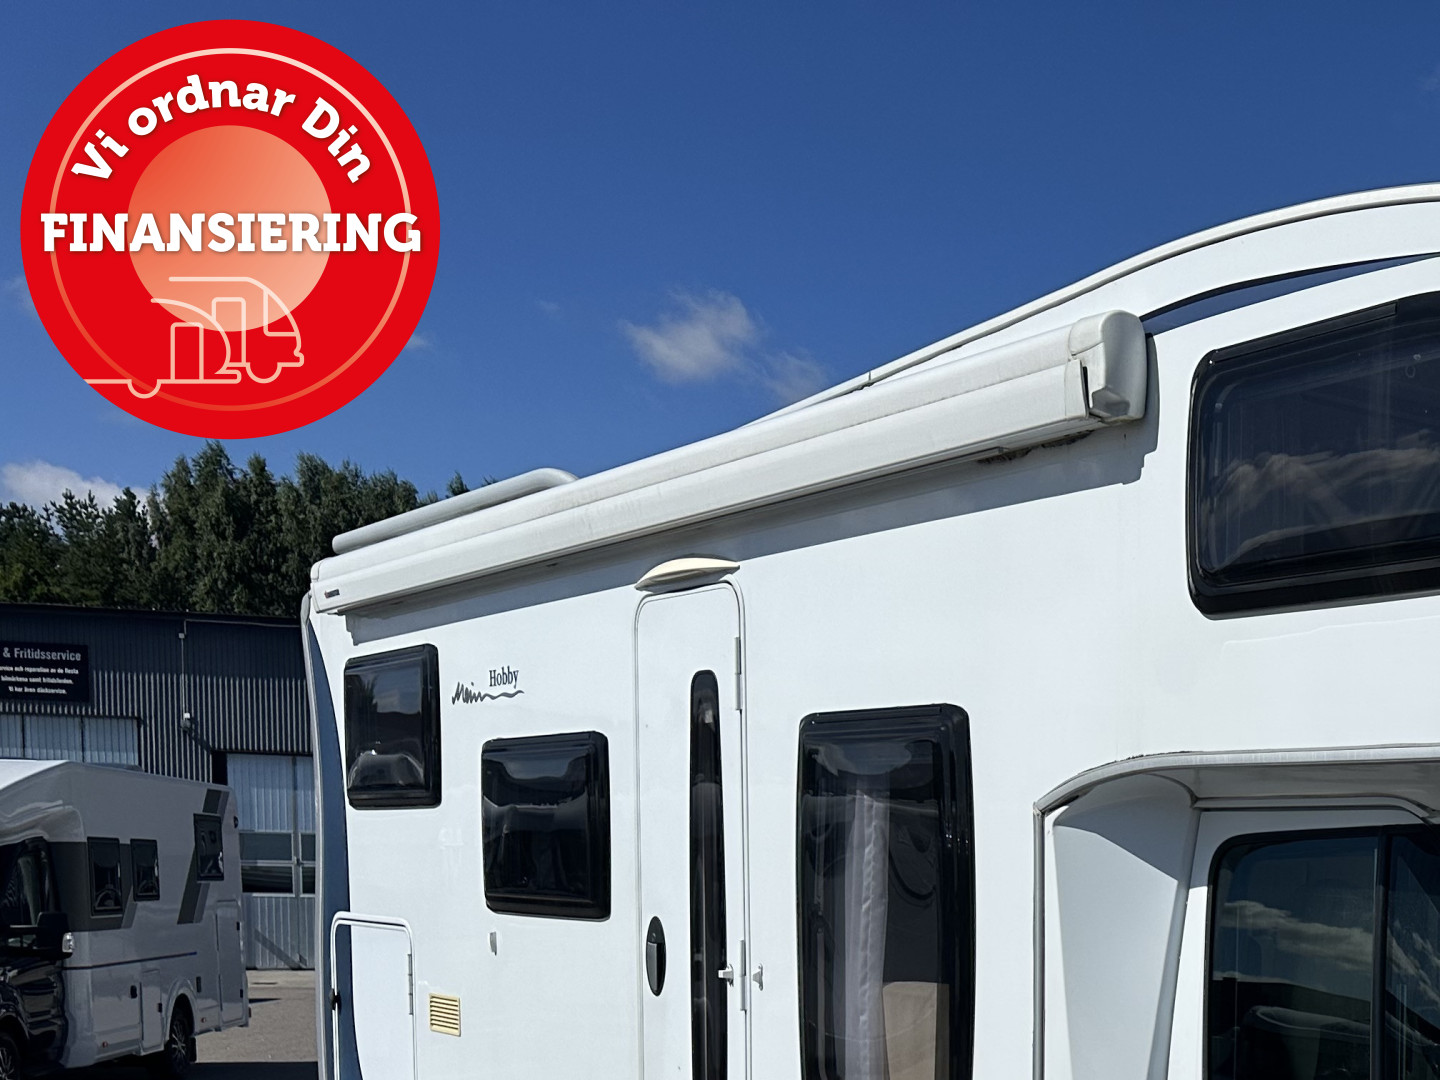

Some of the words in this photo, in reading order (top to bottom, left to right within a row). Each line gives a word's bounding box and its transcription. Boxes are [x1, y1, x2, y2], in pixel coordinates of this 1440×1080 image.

[2, 647, 11, 658] &
[14, 647, 82, 661] Fritidsservice
[489, 665, 519, 689] Hobby
